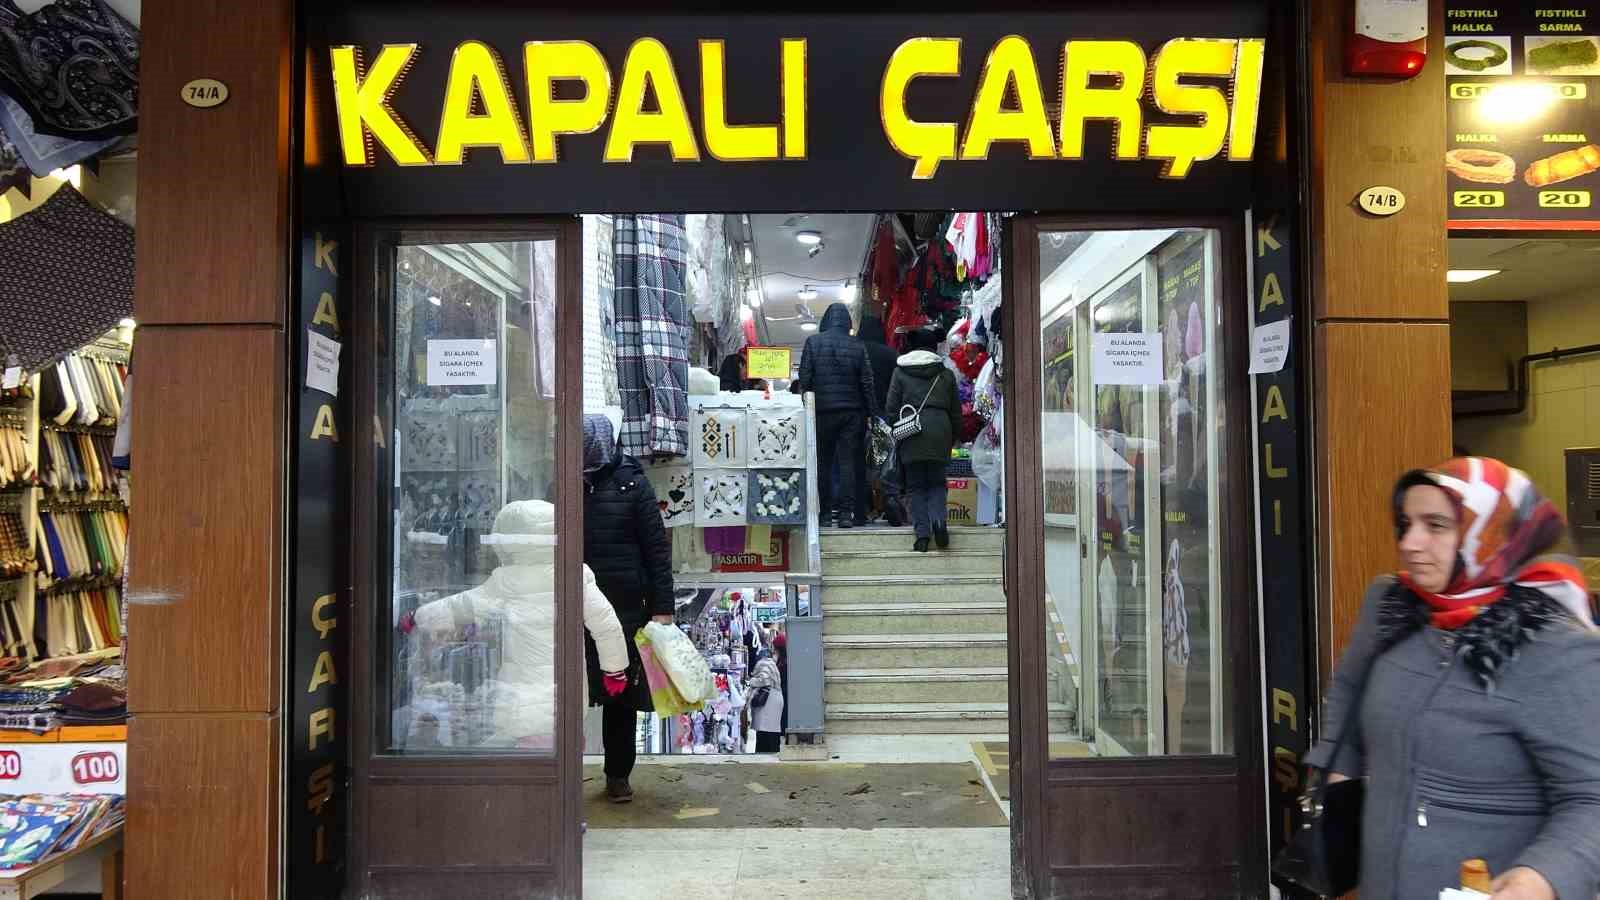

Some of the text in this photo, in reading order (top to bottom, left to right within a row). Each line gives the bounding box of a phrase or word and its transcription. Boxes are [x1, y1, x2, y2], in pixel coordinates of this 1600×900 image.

[1447, 9, 1498, 18] FISTIKLI
[1535, 9, 1587, 18] FISTIKLI
[1452, 23, 1494, 32] HALKA
[1539, 23, 1583, 32] SARMA
[190, 87, 220, 99] 74/A
[330, 34, 1266, 180] KAPALI ÇARŞI
[1368, 194, 1397, 207] 74/B
[1459, 194, 1496, 205] 20
[1544, 193, 1580, 205] 20
[948, 504, 971, 520] mik
[74, 755, 117, 780] 100
